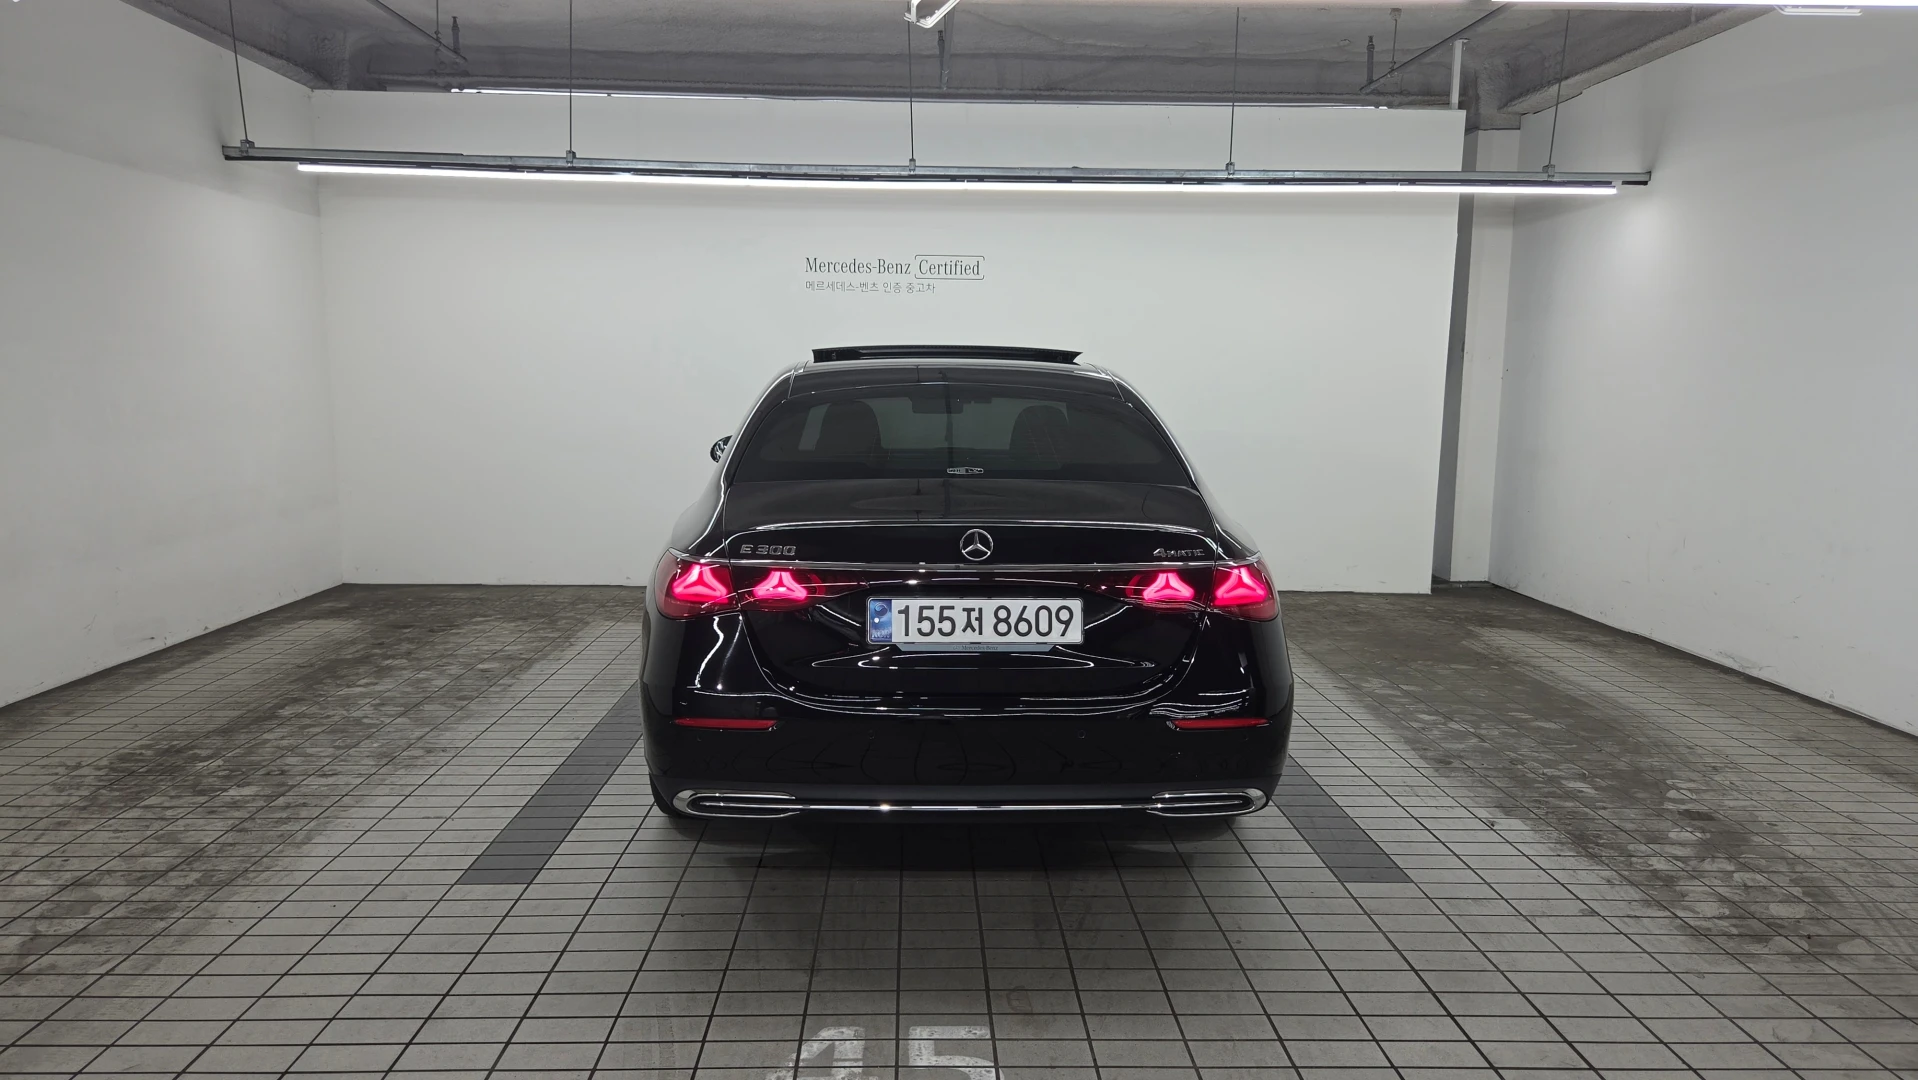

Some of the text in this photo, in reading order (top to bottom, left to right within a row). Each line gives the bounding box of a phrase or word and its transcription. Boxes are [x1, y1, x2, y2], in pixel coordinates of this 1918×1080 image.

[805, 257, 981, 276] Mercedes-Benz Certified
[805, 281, 936, 294] 메르세데스-벤츠 인증 중고차
[740, 544, 797, 556] E 300
[897, 604, 1075, 637] 155저 8609
